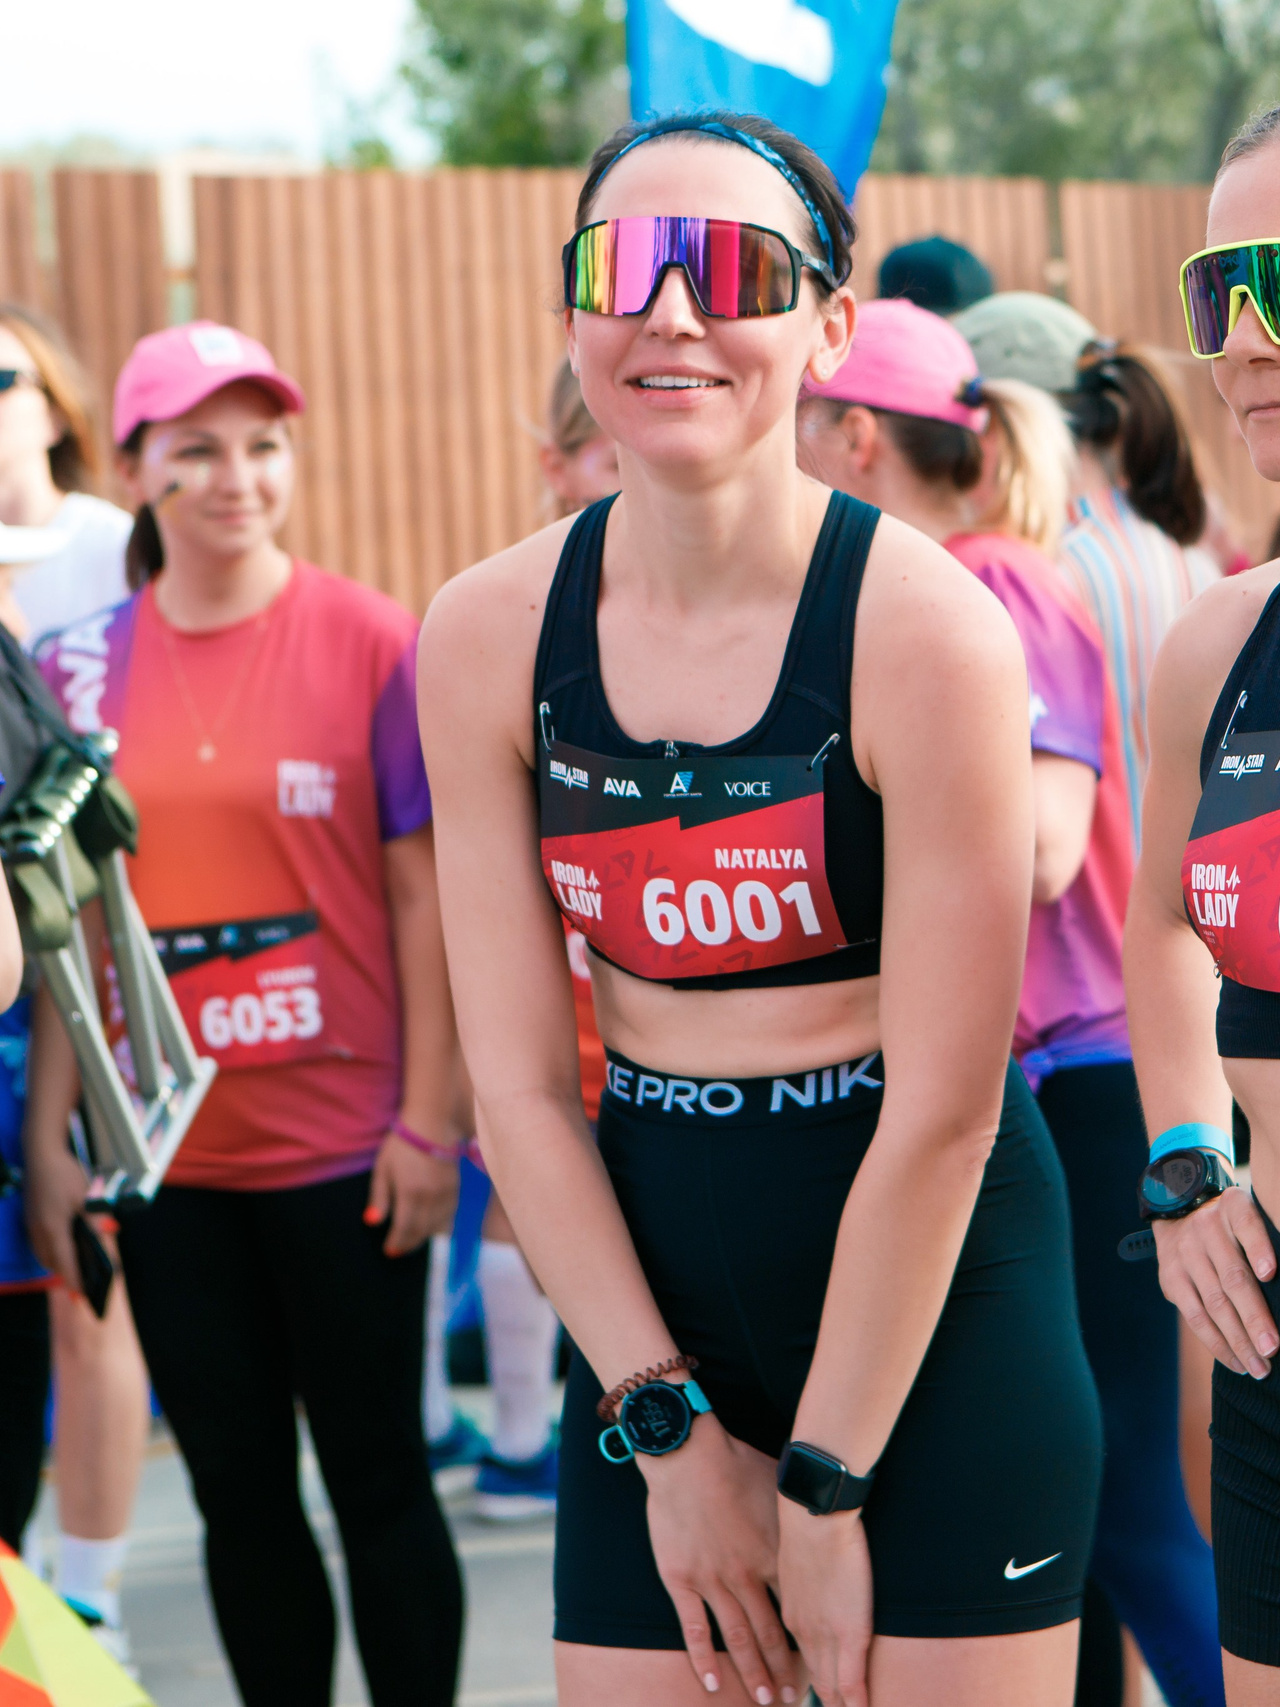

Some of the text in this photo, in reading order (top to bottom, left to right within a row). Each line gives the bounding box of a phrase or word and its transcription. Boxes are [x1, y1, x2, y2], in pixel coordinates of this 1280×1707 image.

[550, 760, 567, 777] IRON
[1221, 755, 1241, 769] IRON
[1245, 754, 1265, 768] STAR
[572, 766, 588, 784] STAR
[603, 777, 642, 798] AVA
[724, 781, 771, 797] VOICE
[714, 848, 808, 869] NATALYA
[551, 860, 587, 889] IRON
[1191, 863, 1227, 891] IRON
[556, 883, 602, 921] LADY
[642, 878, 822, 945] 6001
[1192, 892, 1240, 928] LADY
[200, 986, 322, 1049] 6053
